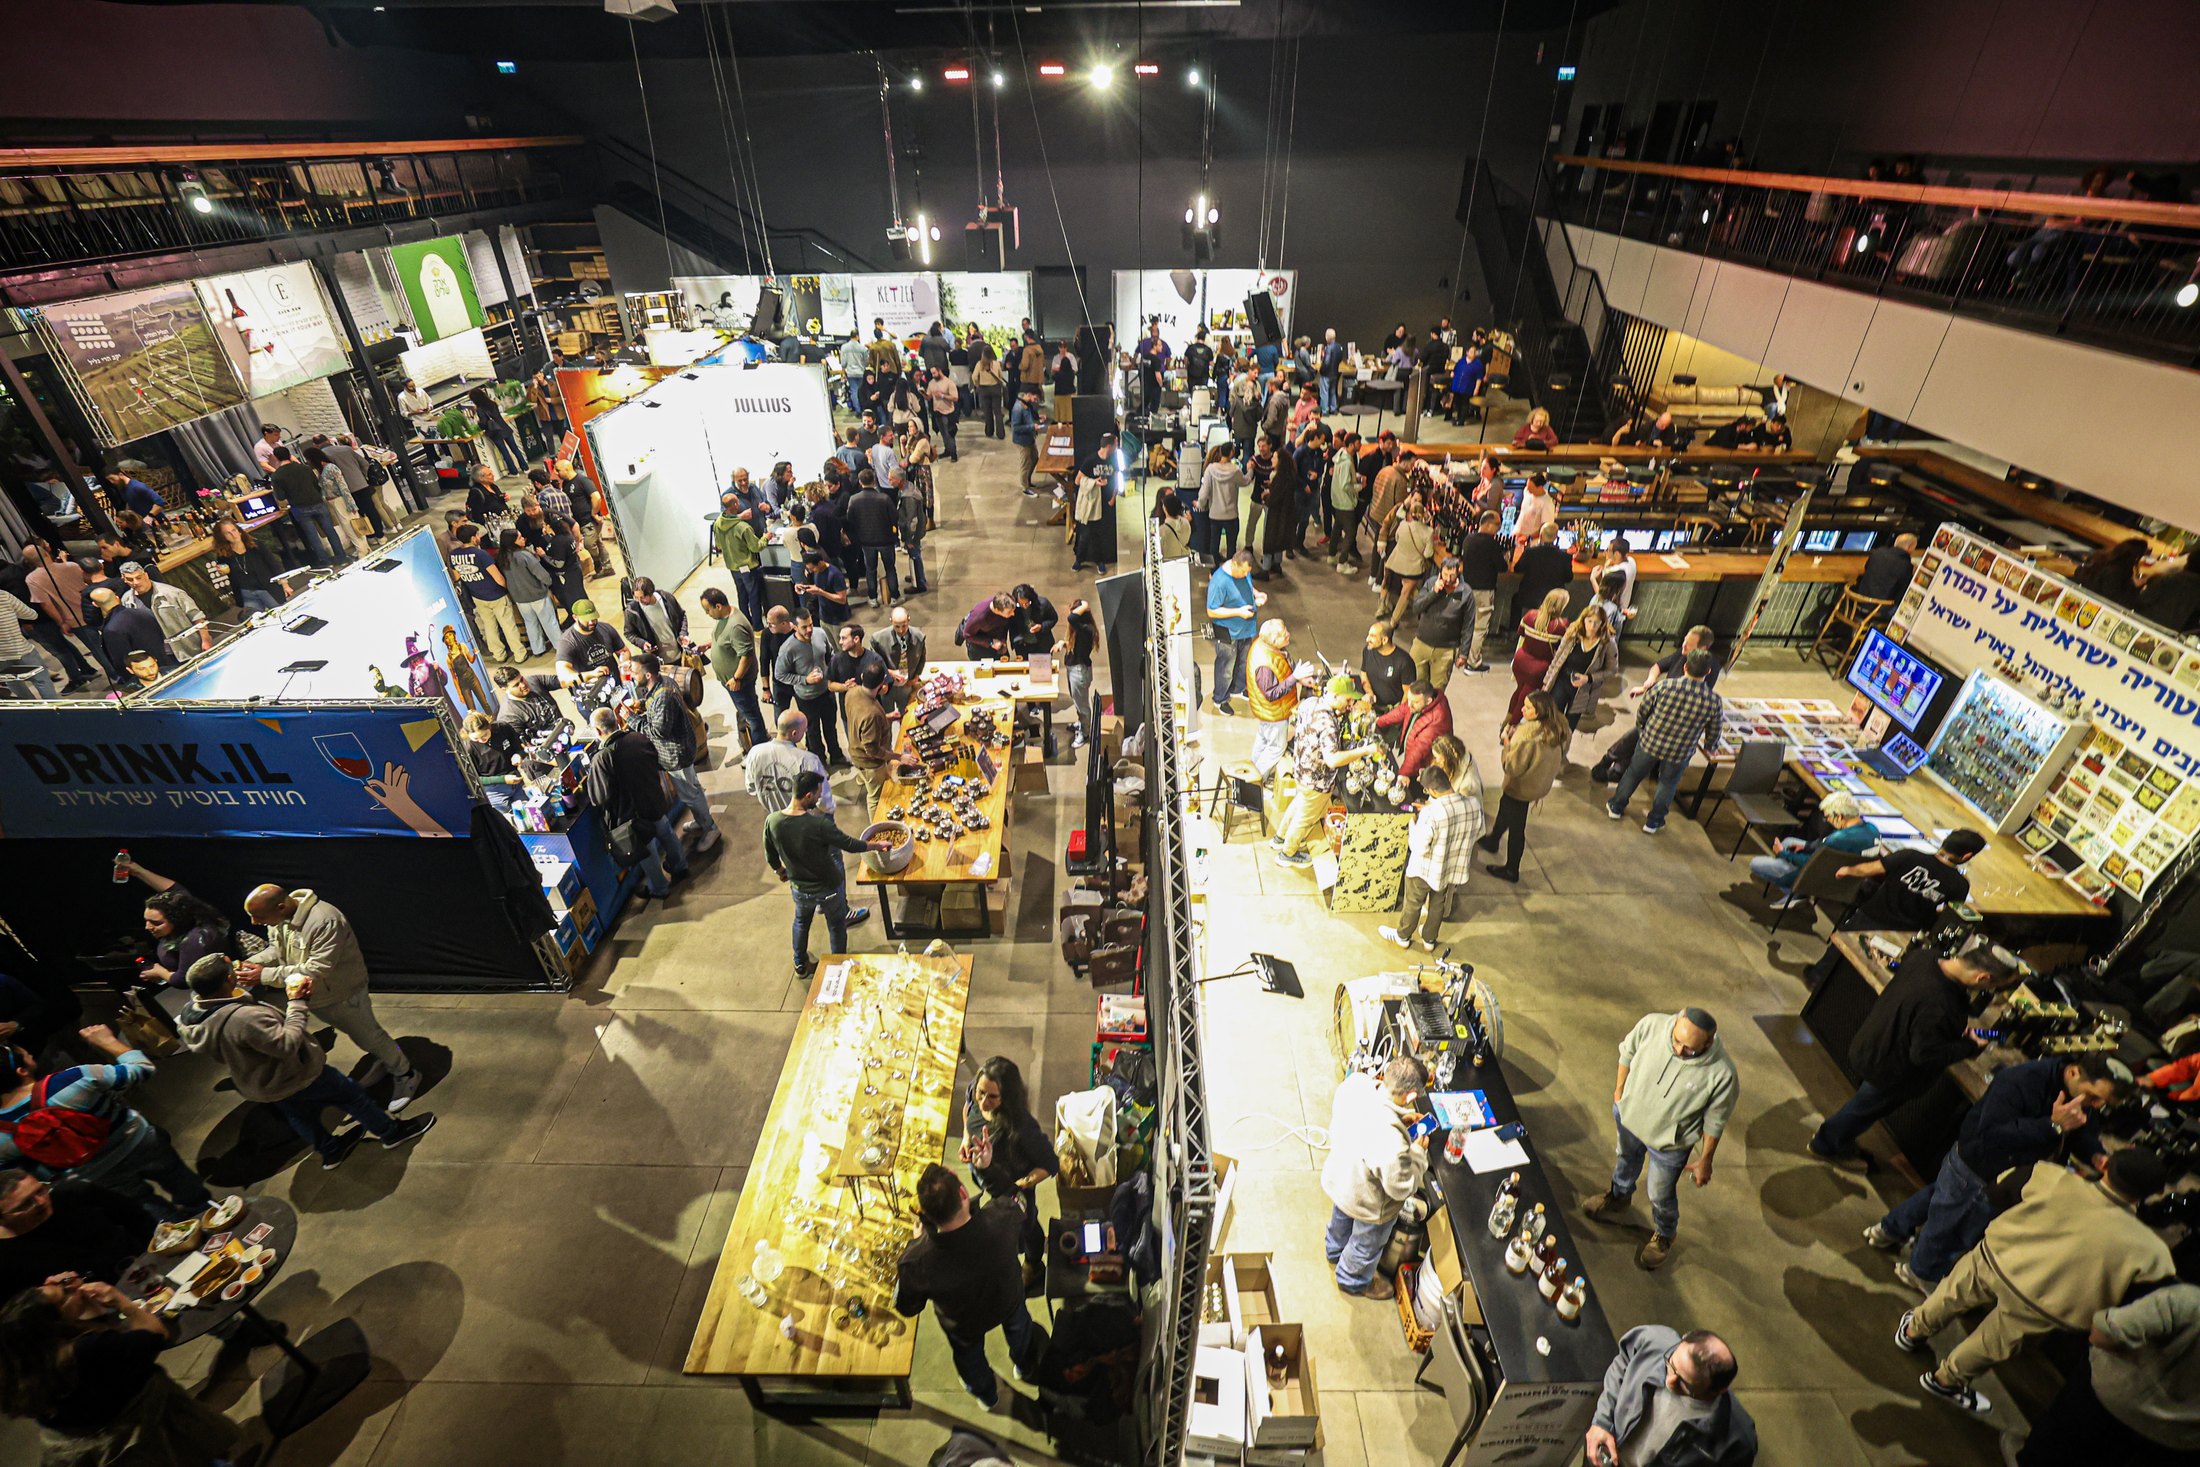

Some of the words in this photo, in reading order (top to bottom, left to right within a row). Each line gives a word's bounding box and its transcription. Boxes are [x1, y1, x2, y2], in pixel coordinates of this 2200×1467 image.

[276, 283, 289, 300] E
[734, 397, 791, 413] JULLIUS
[450, 553, 476, 566] BUILT
[460, 571, 485, 583] OUGH
[1942, 564, 1988, 603] המדף
[1927, 595, 1972, 630] ישראל
[1991, 588, 2018, 616] על
[1974, 626, 2015, 665] בארץ
[2020, 609, 2118, 669] ישראלית
[2021, 651, 2086, 701] אלכוהול
[2121, 666, 2200, 728] טוריה
[2092, 698, 2147, 742] ויצרני
[14, 743, 294, 785] DRINK.IL
[51, 790, 158, 807] ישראלית
[165, 790, 241, 808] בוטיק
[242, 790, 307, 806] חווית
[531, 845, 547, 855] The
